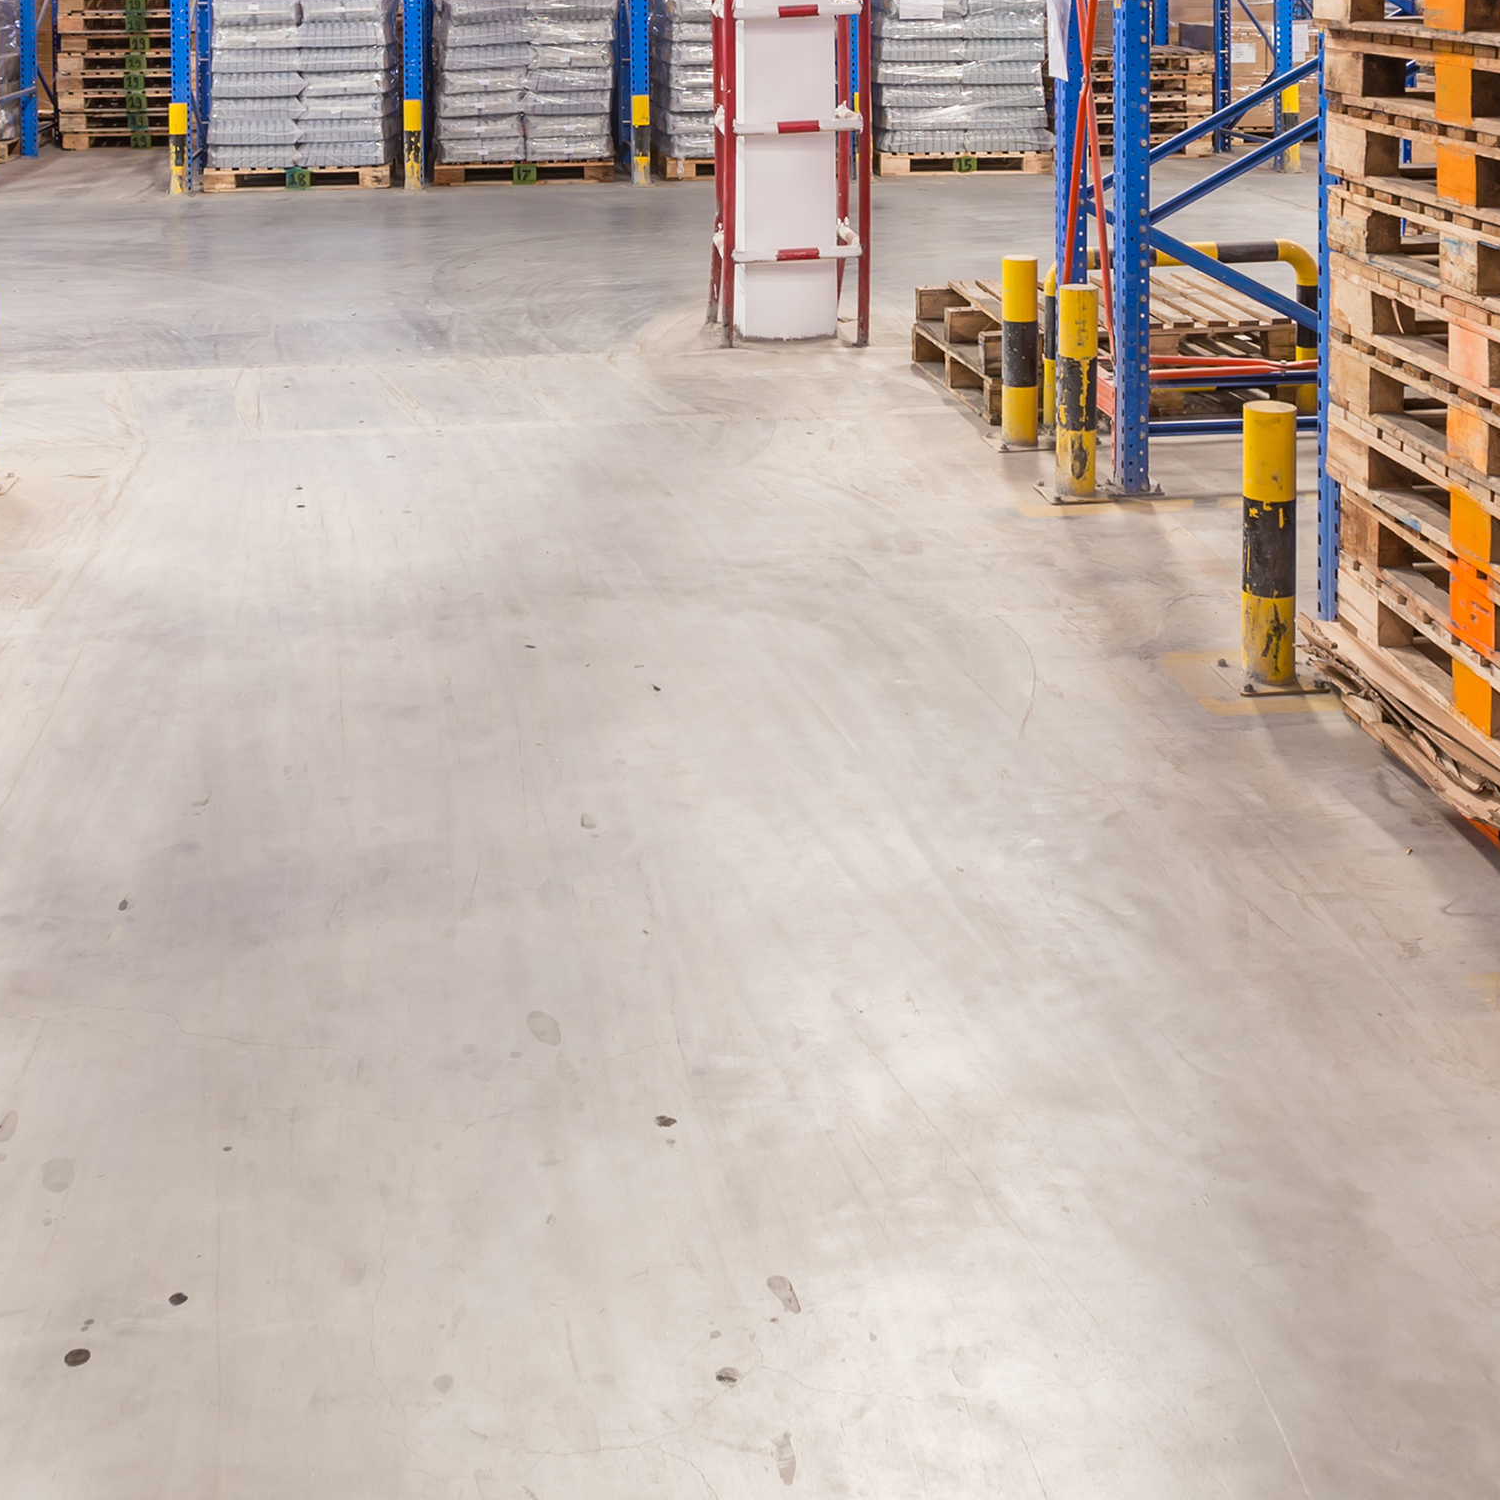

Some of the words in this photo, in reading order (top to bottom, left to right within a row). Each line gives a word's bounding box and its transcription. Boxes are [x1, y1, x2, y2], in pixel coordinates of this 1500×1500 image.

[957, 158, 973, 172] 15
[288, 173, 307, 188] 18
[517, 166, 531, 181] 17
